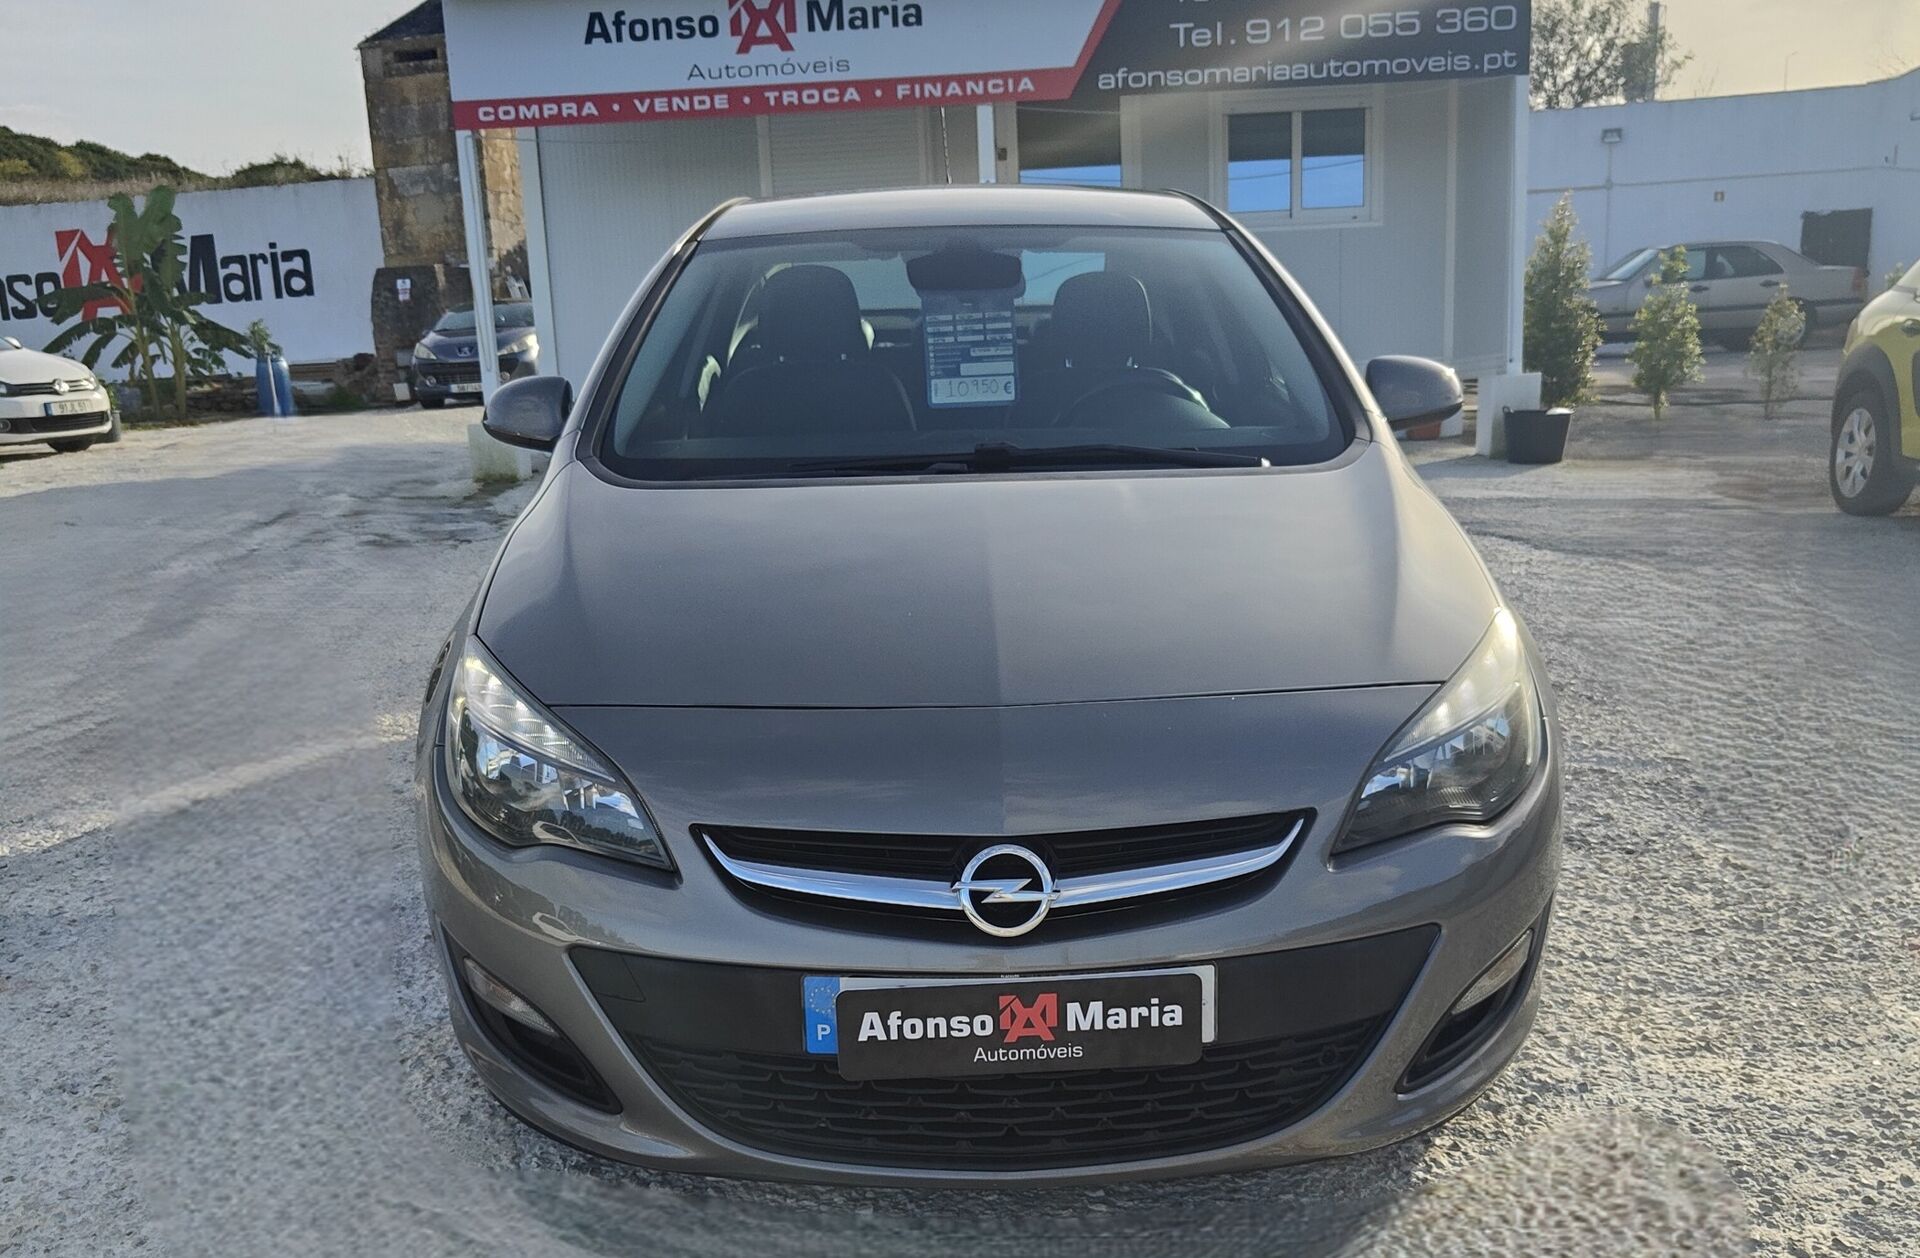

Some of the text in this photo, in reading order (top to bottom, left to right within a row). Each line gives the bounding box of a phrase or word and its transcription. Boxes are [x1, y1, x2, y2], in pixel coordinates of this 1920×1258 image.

[584, 0, 923, 45] Afonso Maria
[1168, 5, 1517, 48] Tel. 912 055 360
[687, 57, 851, 81] Automóveis
[1097, 49, 1518, 90] afonsomariaautomoveis.pt
[478, 77, 1035, 122] COMPRA VENDE TROCA FINANCIA
[816, 1024, 831, 1041] P
[857, 998, 1183, 1042] Afonso Maria
[973, 1042, 1084, 1063] Automóveis
